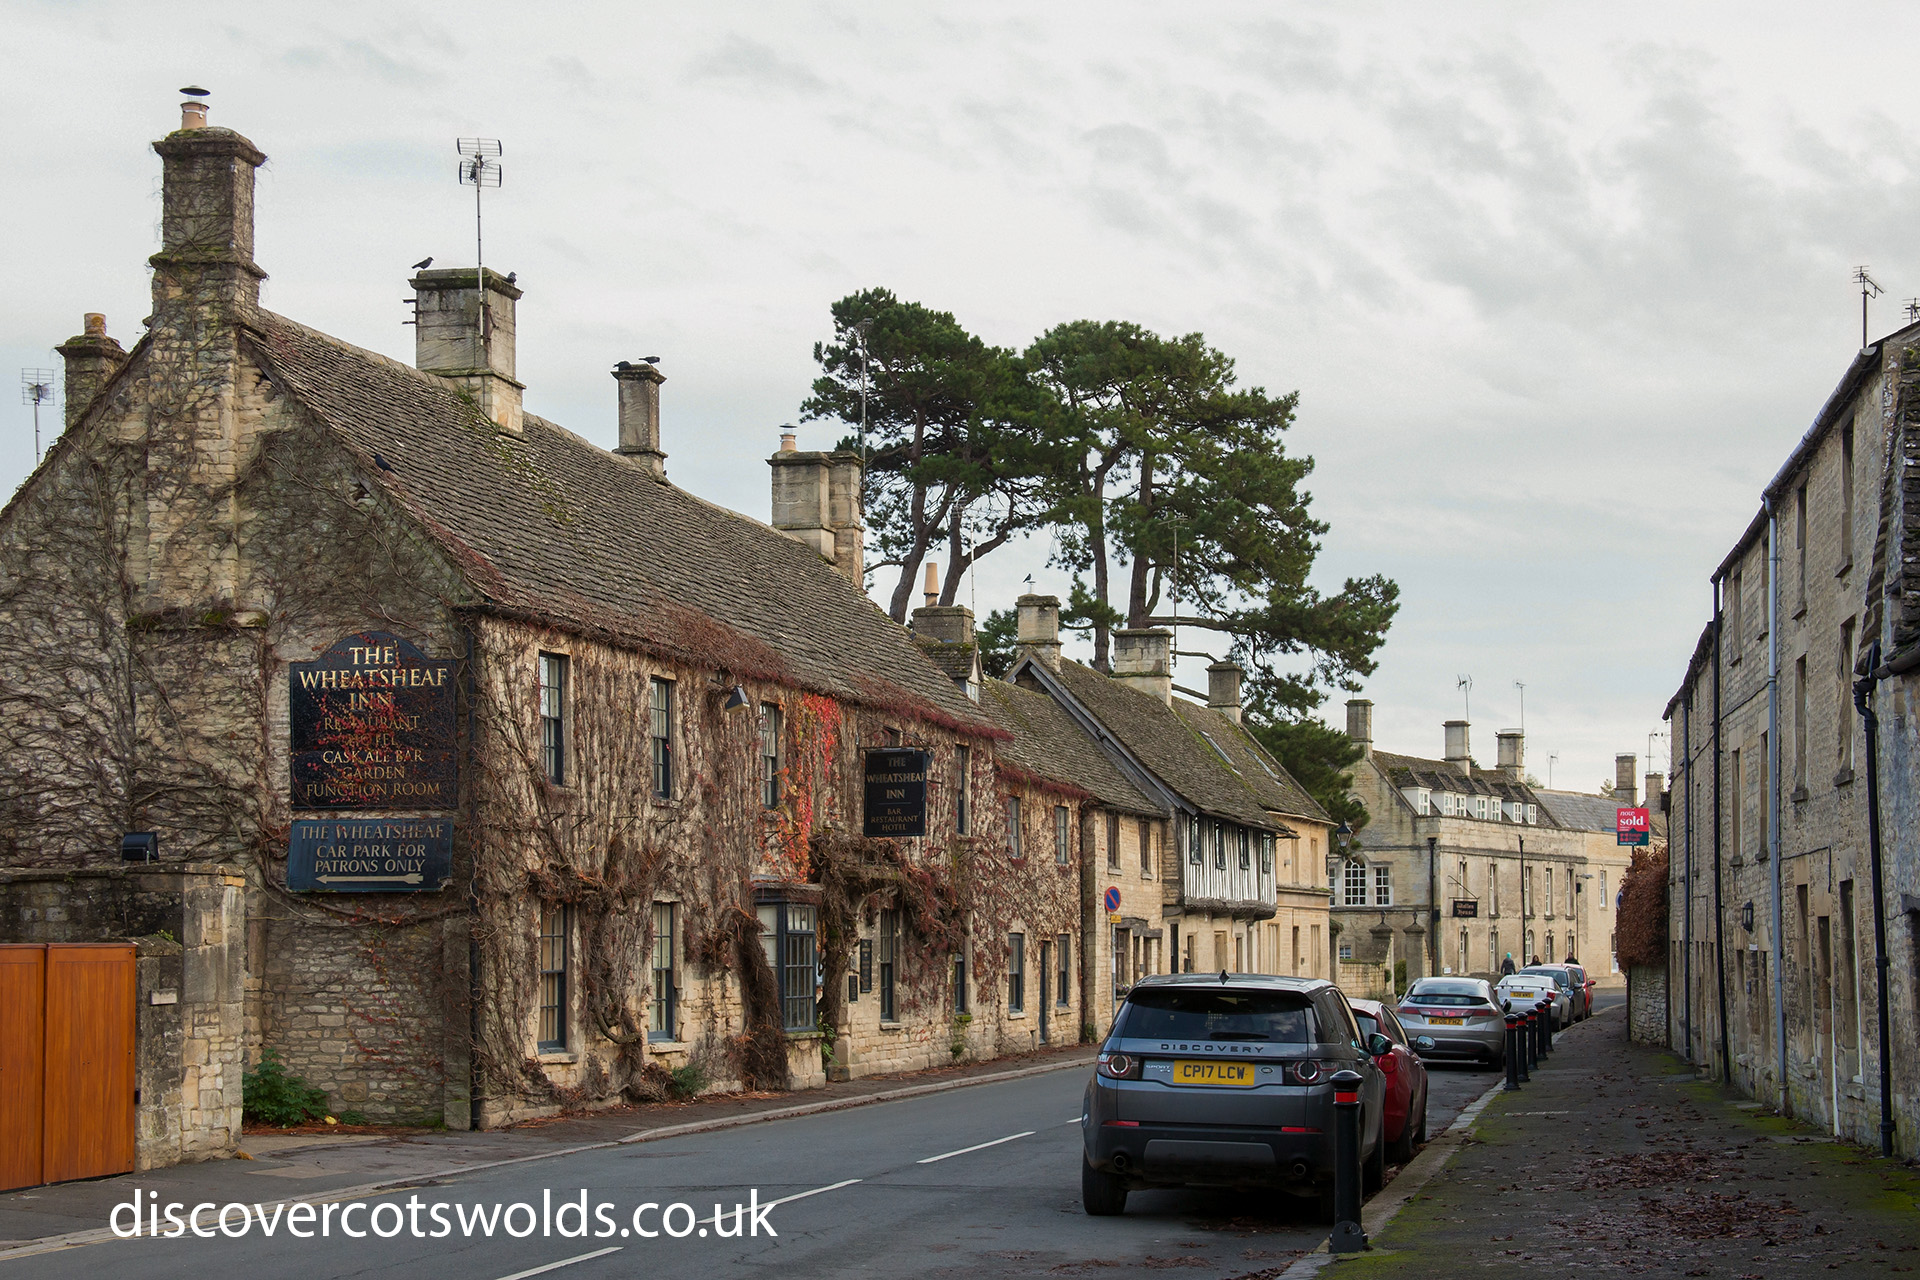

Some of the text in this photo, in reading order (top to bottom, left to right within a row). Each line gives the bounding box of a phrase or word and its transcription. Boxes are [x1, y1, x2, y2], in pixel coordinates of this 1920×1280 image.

[349, 646, 394, 665] THE
[298, 668, 448, 689] WHEATSHEAF
[349, 692, 394, 711] INN
[322, 750, 361, 764] CASK
[396, 749, 426, 763] BAR
[888, 757, 906, 767] THE
[343, 766, 405, 779] GARDEN
[866, 772, 926, 784] WHEATSHEAF
[306, 781, 441, 797] FUNCTION ROOM
[886, 788, 905, 800] INN
[871, 815, 919, 824] RESTAURANT
[300, 824, 444, 840] THE WHEATSHEAF
[882, 824, 907, 832] HOTEL
[316, 843, 426, 858] CAR PARK FOR
[314, 859, 426, 873] PATRONS ONLY
[1160, 1043, 1264, 1053] DISCOVERY
[1183, 1064, 1216, 1079] CP17
[1217, 1066, 1246, 1080] LCW
